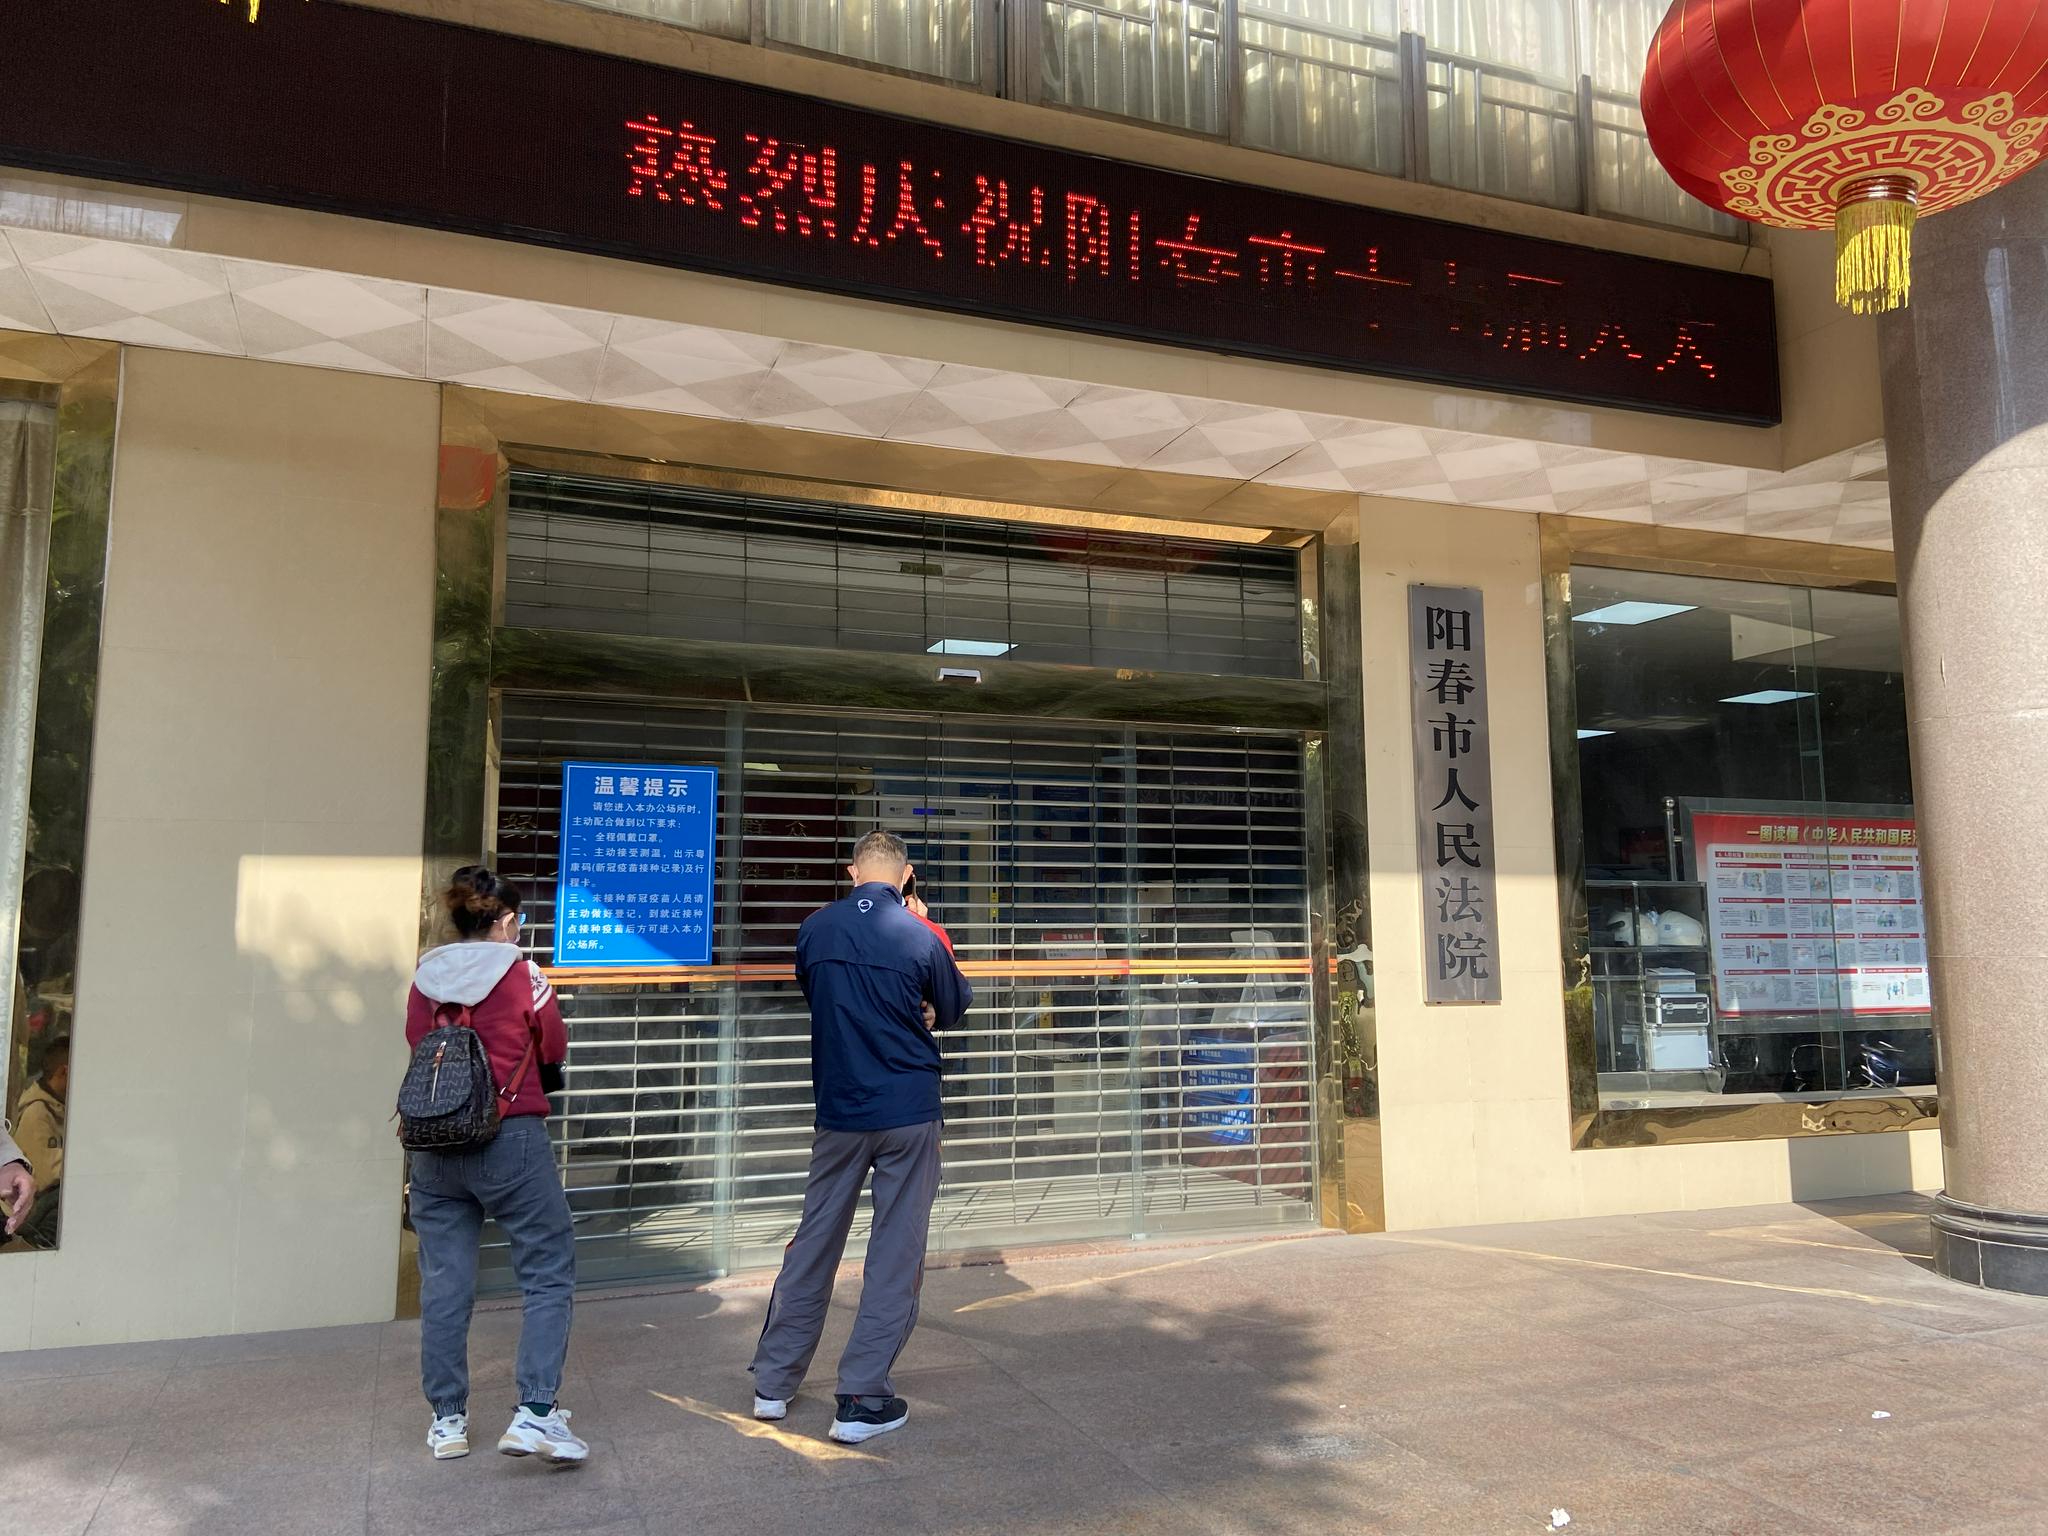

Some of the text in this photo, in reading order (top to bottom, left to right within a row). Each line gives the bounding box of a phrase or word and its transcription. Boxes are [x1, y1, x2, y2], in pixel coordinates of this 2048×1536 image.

[594, 776, 688, 797] 温馨提示
[1426, 605, 1489, 981] 阳春市人民法院
[566, 939, 604, 950] 公场所。
